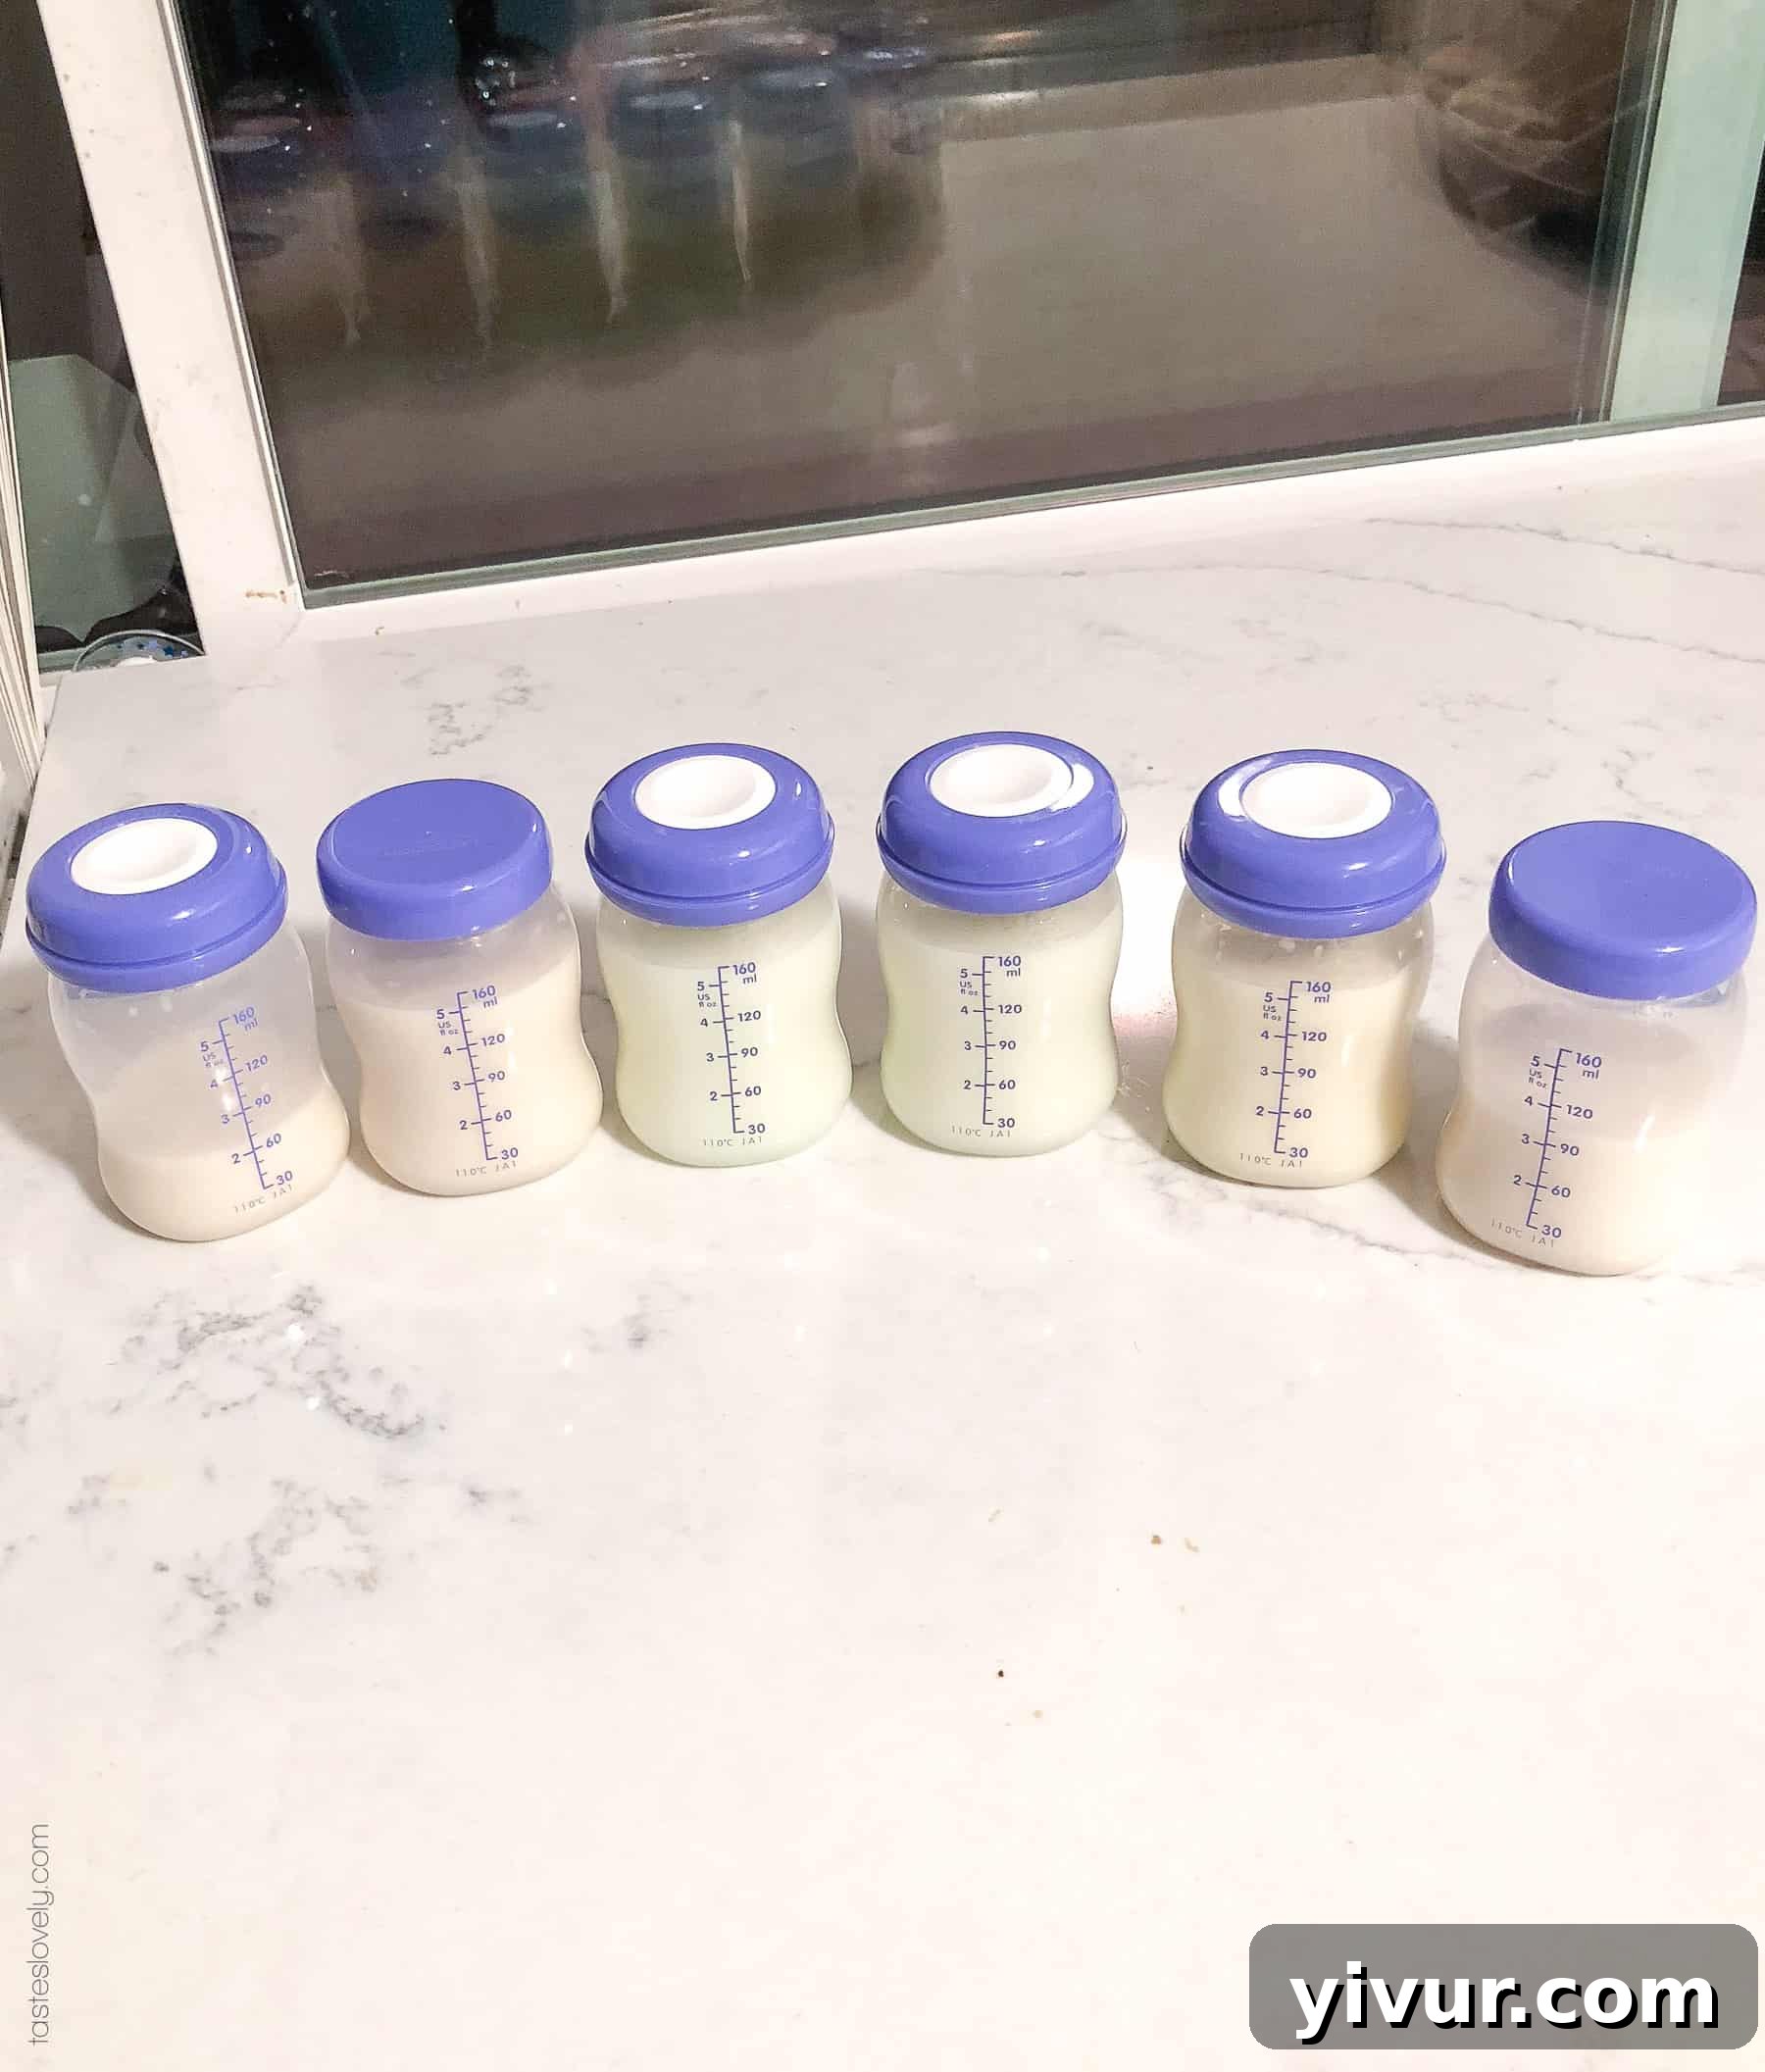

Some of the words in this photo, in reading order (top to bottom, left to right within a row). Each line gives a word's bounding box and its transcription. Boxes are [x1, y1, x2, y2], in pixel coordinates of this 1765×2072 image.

[997, 956, 1021, 967] 160
[732, 962, 756, 976] 160
[960, 969, 968, 978] 5
[1006, 968, 1021, 977] ml
[742, 974, 757, 985] ml
[697, 982, 705, 991] 5
[1306, 982, 1332, 993] 160
[472, 985, 495, 999] 160
[483, 997, 498, 1008] ml
[1264, 993, 1273, 1002] 5
[1314, 994, 1330, 1003] ml
[436, 1009, 445, 1019] 5
[998, 1004, 1022, 1014] 120
[232, 1006, 255, 1026] 160
[737, 1011, 761, 1022] 120
[244, 1018, 259, 1031] ml
[481, 1034, 505, 1046] 120
[1261, 1031, 1269, 1039] 4
[1301, 1032, 1327, 1041] 120
[200, 1041, 209, 1052] 5
[965, 1041, 971, 1050] 3
[999, 1040, 1016, 1050] 90
[443, 1046, 452, 1055] 4
[741, 1047, 758, 1057] 90
[706, 1053, 714, 1062] 3
[1532, 1056, 1540, 1067] 5
[1576, 1053, 1602, 1068] 160
[245, 1055, 268, 1072] 120
[1260, 1067, 1268, 1076] 3
[1297, 1069, 1317, 1079] 90
[1530, 1070, 1541, 1079] US
[1582, 1069, 1599, 1080] ml
[488, 1071, 505, 1083] 90
[210, 1079, 219, 1088] 4
[453, 1082, 461, 1090] 3
[963, 1081, 971, 1089] 2
[999, 1080, 1016, 1089] 60
[710, 1091, 718, 1100] 2
[744, 1087, 762, 1096] 60
[255, 1093, 272, 1108] 90
[1525, 1096, 1533, 1106] 4
[495, 1110, 512, 1122] 60
[1256, 1106, 1264, 1116] 2
[1293, 1109, 1312, 1119] 60
[1567, 1105, 1593, 1120] 120
[222, 1115, 229, 1124] 3
[997, 1118, 1015, 1128] 30
[460, 1120, 468, 1130] 2
[748, 1124, 766, 1135] 30
[266, 1133, 281, 1147] 60
[1522, 1135, 1530, 1143] 3
[501, 1147, 519, 1160] 30
[1289, 1147, 1308, 1158] 30
[1560, 1143, 1580, 1156] 90
[231, 1153, 241, 1164] 2
[277, 1170, 293, 1187] 30
[1514, 1176, 1521, 1186] 2
[1551, 1186, 1571, 1198] 60
[1541, 1226, 1562, 1238] 30
